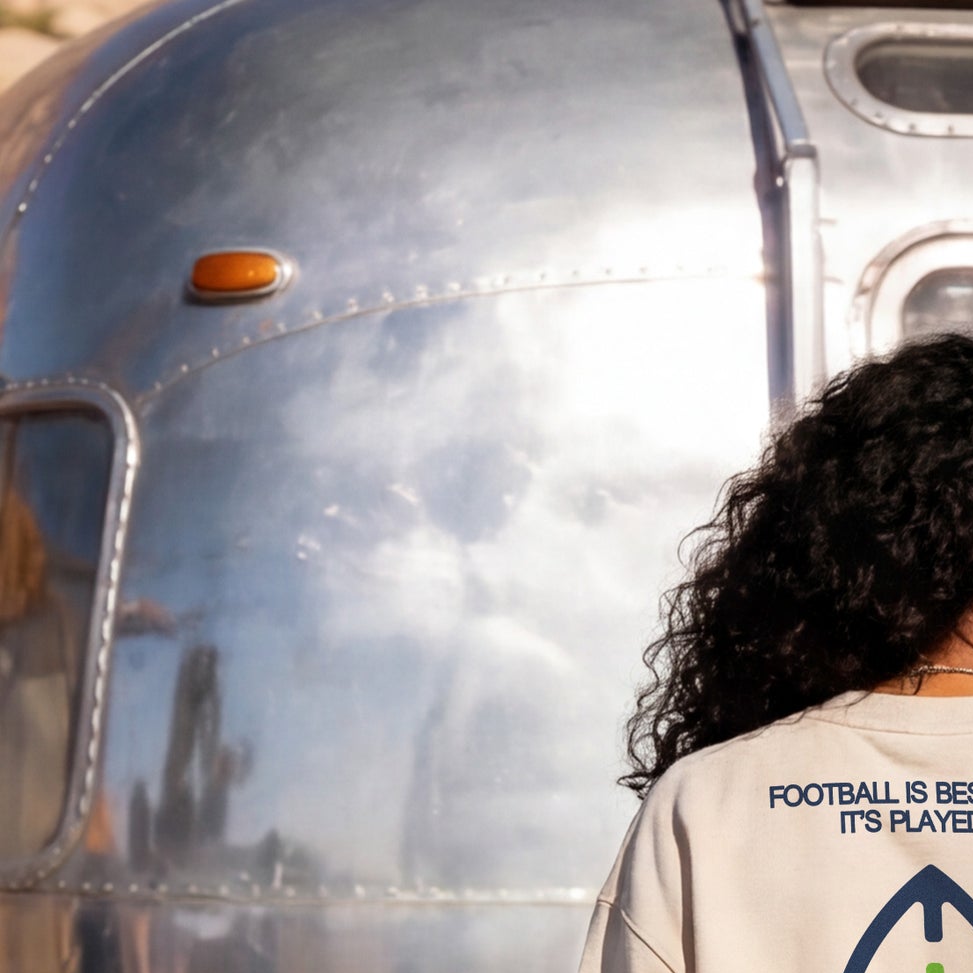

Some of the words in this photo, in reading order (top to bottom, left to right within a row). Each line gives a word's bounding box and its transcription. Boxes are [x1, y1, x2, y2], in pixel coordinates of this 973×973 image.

[769, 781, 900, 809] FOOTBALL
[905, 780, 929, 804] IS
[840, 810, 882, 834] IT'S
